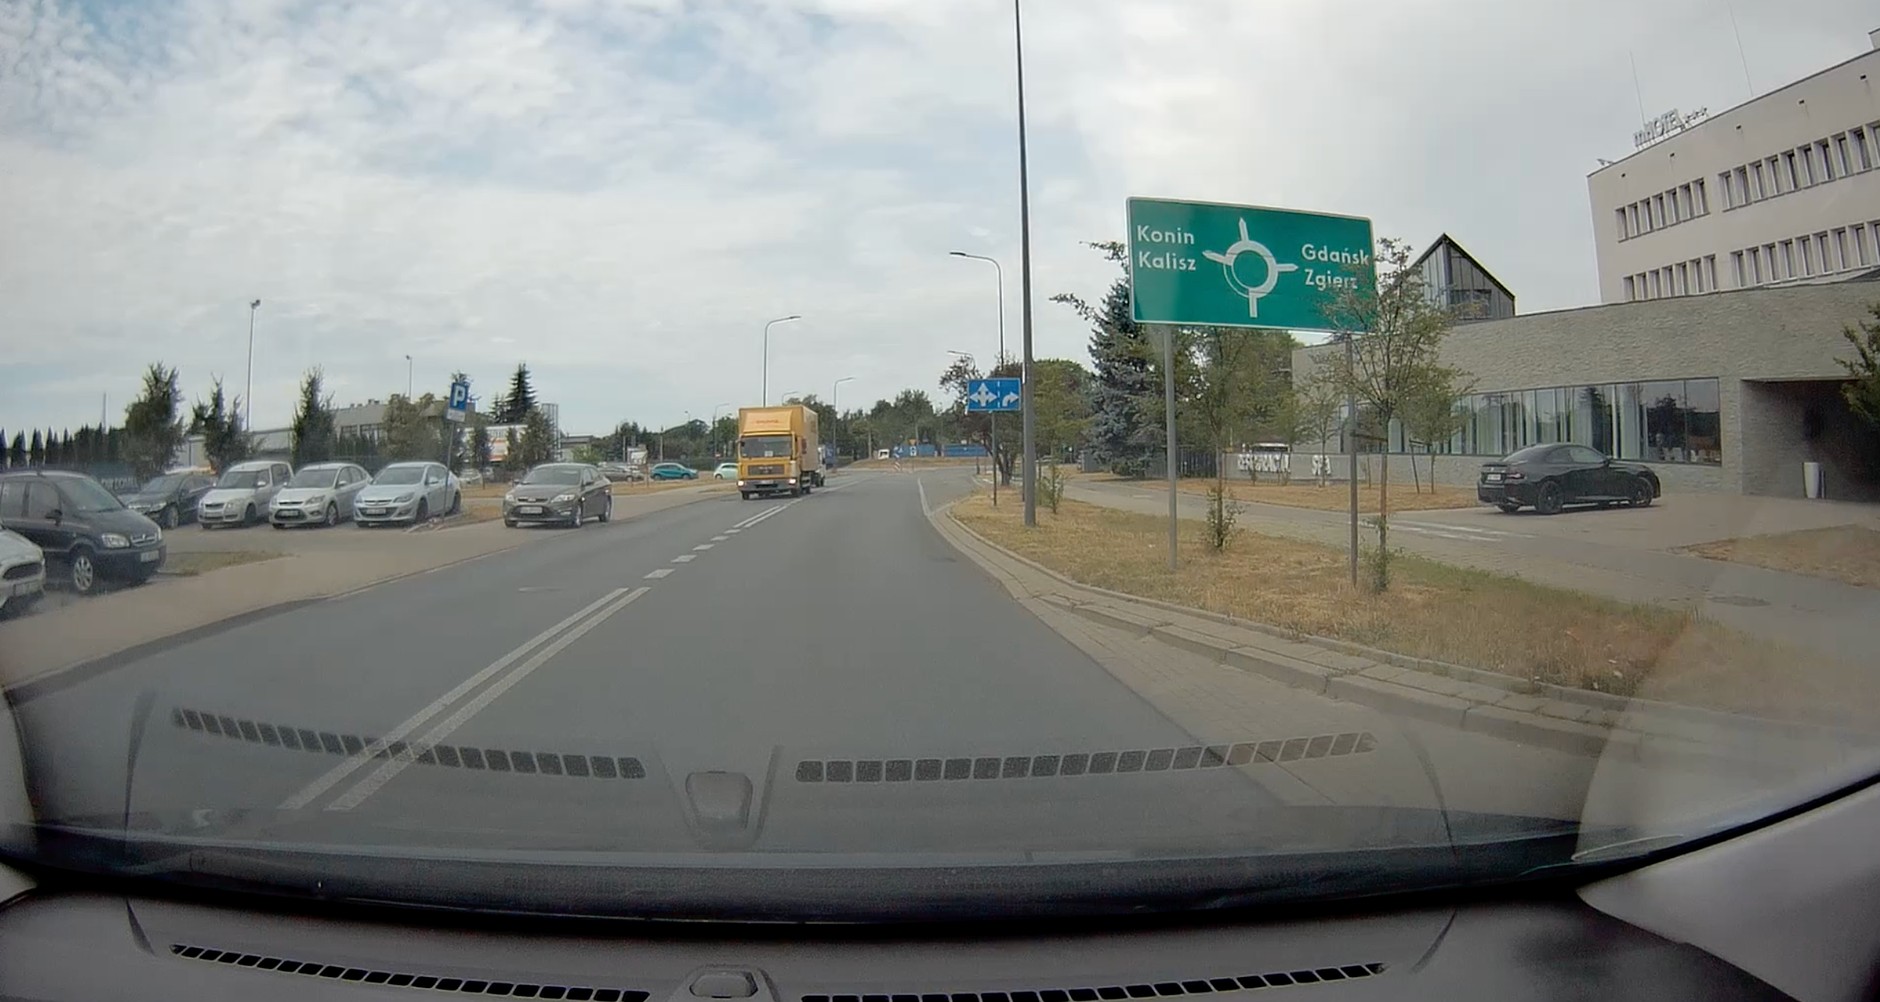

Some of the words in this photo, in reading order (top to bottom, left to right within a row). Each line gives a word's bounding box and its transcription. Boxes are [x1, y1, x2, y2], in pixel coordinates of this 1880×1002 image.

[1136, 224, 1195, 245] Konin
[1138, 251, 1197, 272] Kalisz
[1301, 243, 1369, 265] Gdańsk
[1304, 268, 1358, 291] Zgierz
[453, 385, 466, 407] P
